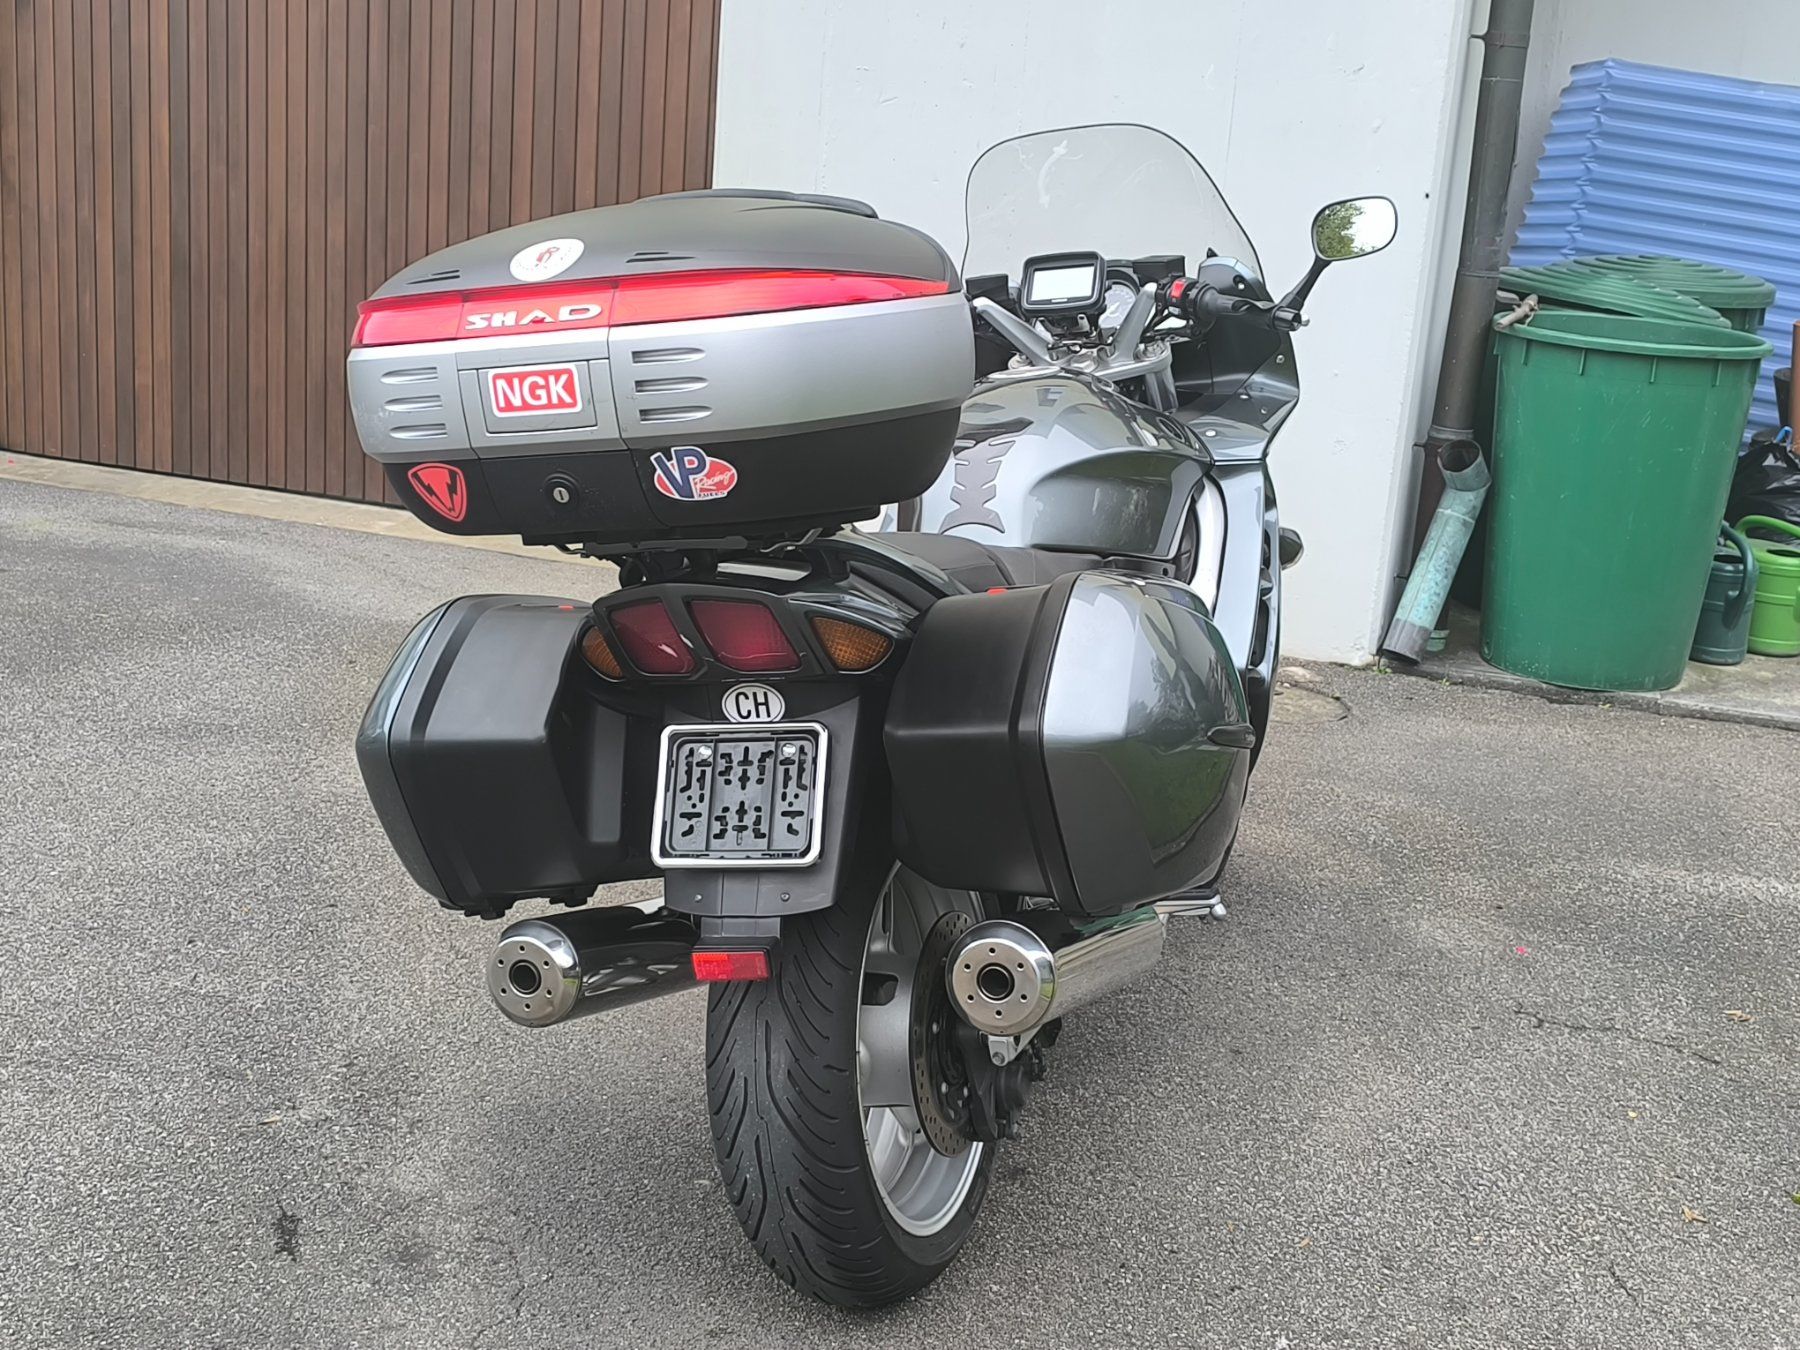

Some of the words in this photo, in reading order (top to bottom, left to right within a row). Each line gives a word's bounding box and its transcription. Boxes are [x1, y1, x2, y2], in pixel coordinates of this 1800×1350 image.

[464, 303, 602, 330] SHAD
[495, 373, 574, 408] NGK
[652, 447, 707, 499] VP
[735, 691, 771, 719] CH
